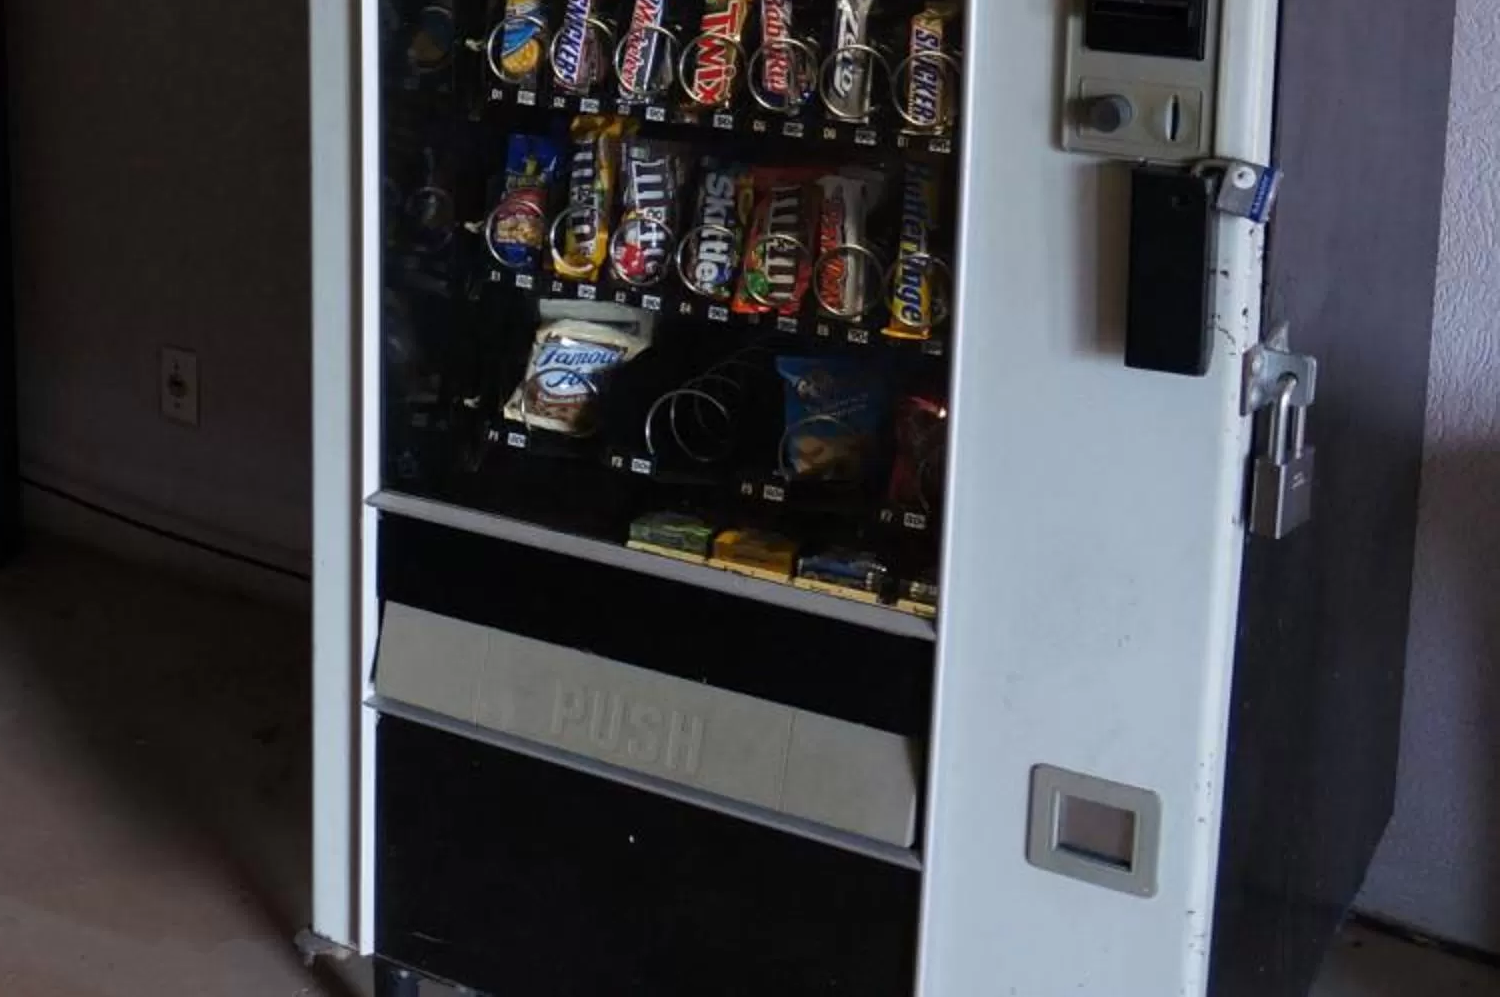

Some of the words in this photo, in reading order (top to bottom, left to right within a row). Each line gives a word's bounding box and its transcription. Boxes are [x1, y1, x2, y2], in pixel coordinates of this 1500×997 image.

[698, 0, 740, 104] TWIX
[913, 28, 939, 124] SNICKER
[895, 162, 931, 324] Butterfinge
[551, 678, 706, 774] PUSH
